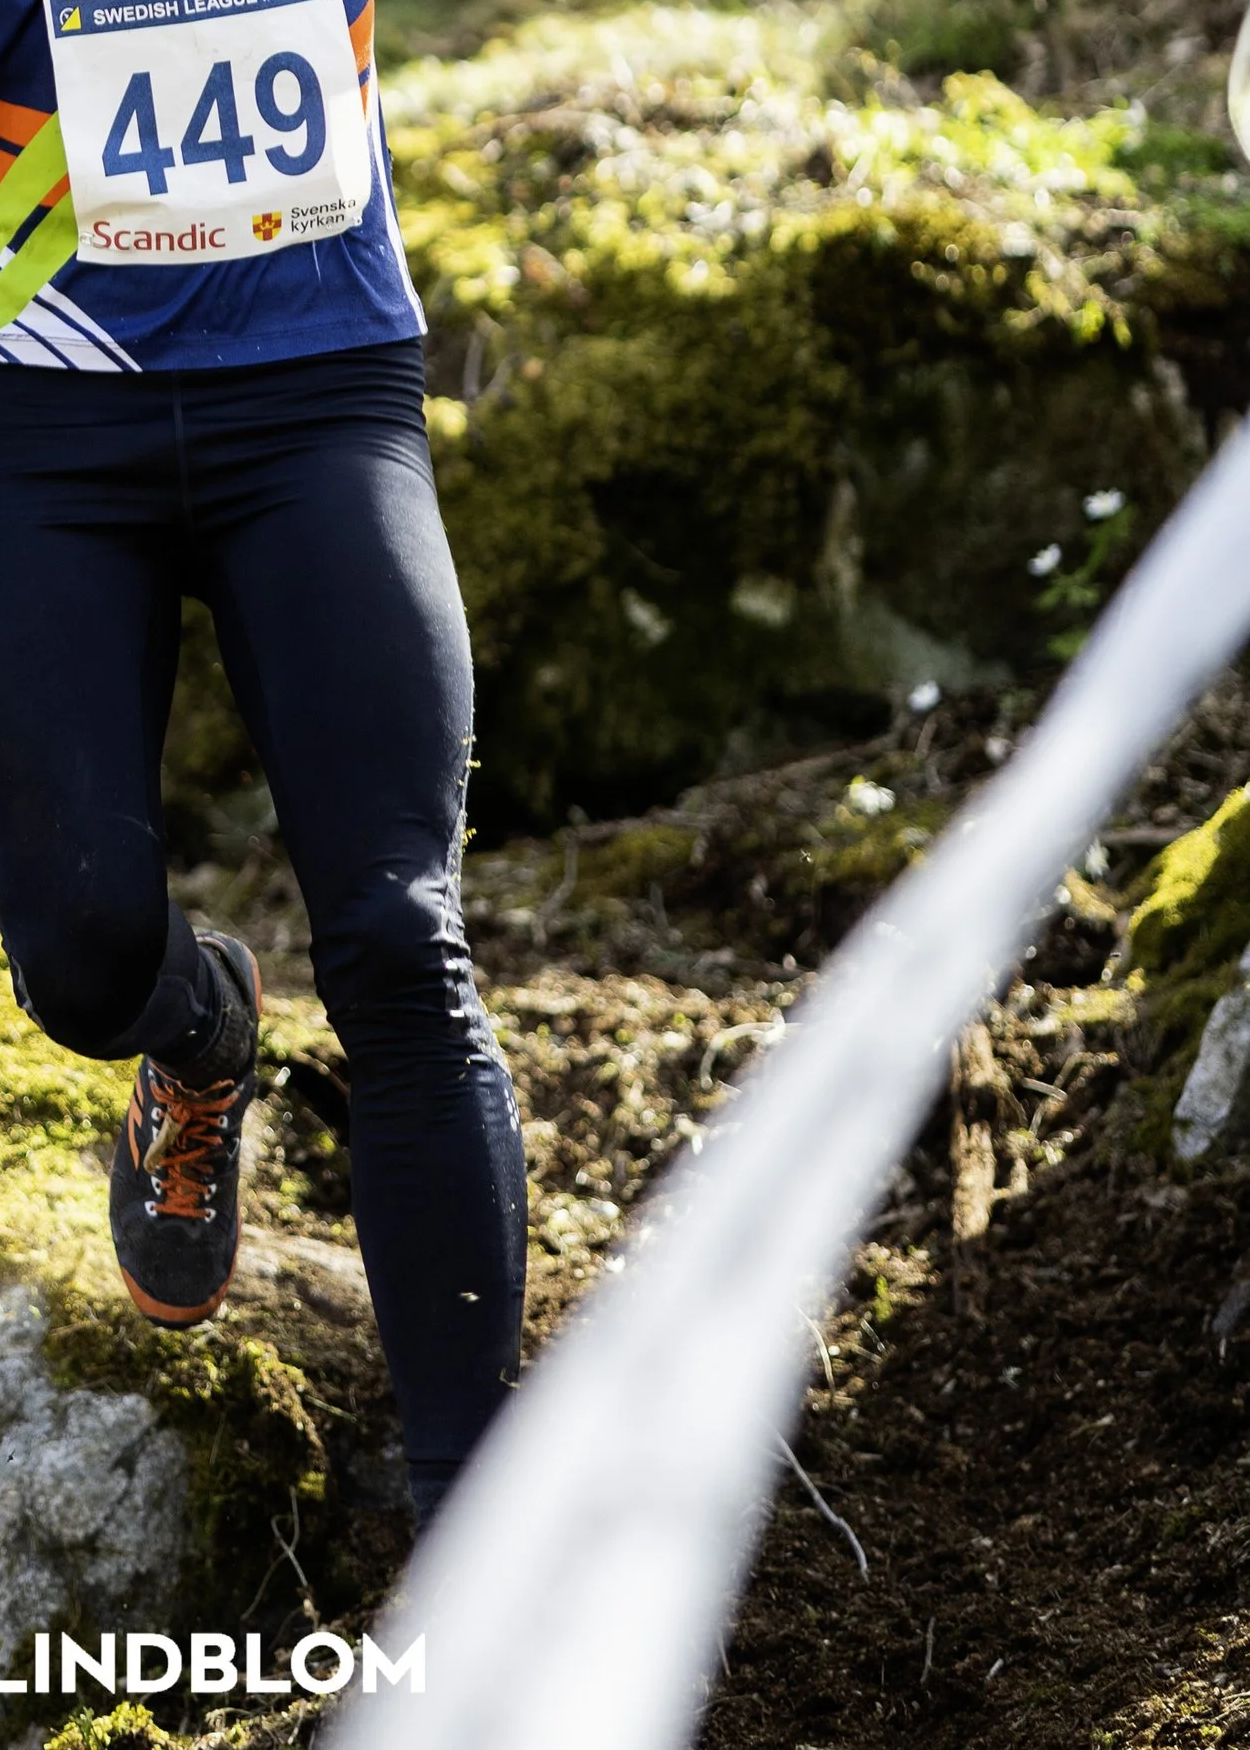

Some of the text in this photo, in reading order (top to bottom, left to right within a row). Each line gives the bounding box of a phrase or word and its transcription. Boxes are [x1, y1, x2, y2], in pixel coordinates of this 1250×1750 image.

[93, 3, 179, 26] SWEDISH
[102, 51, 327, 196] 449
[291, 198, 356, 219] Svenska
[291, 213, 345, 234] kyrkan
[92, 220, 226, 251] Scandic
